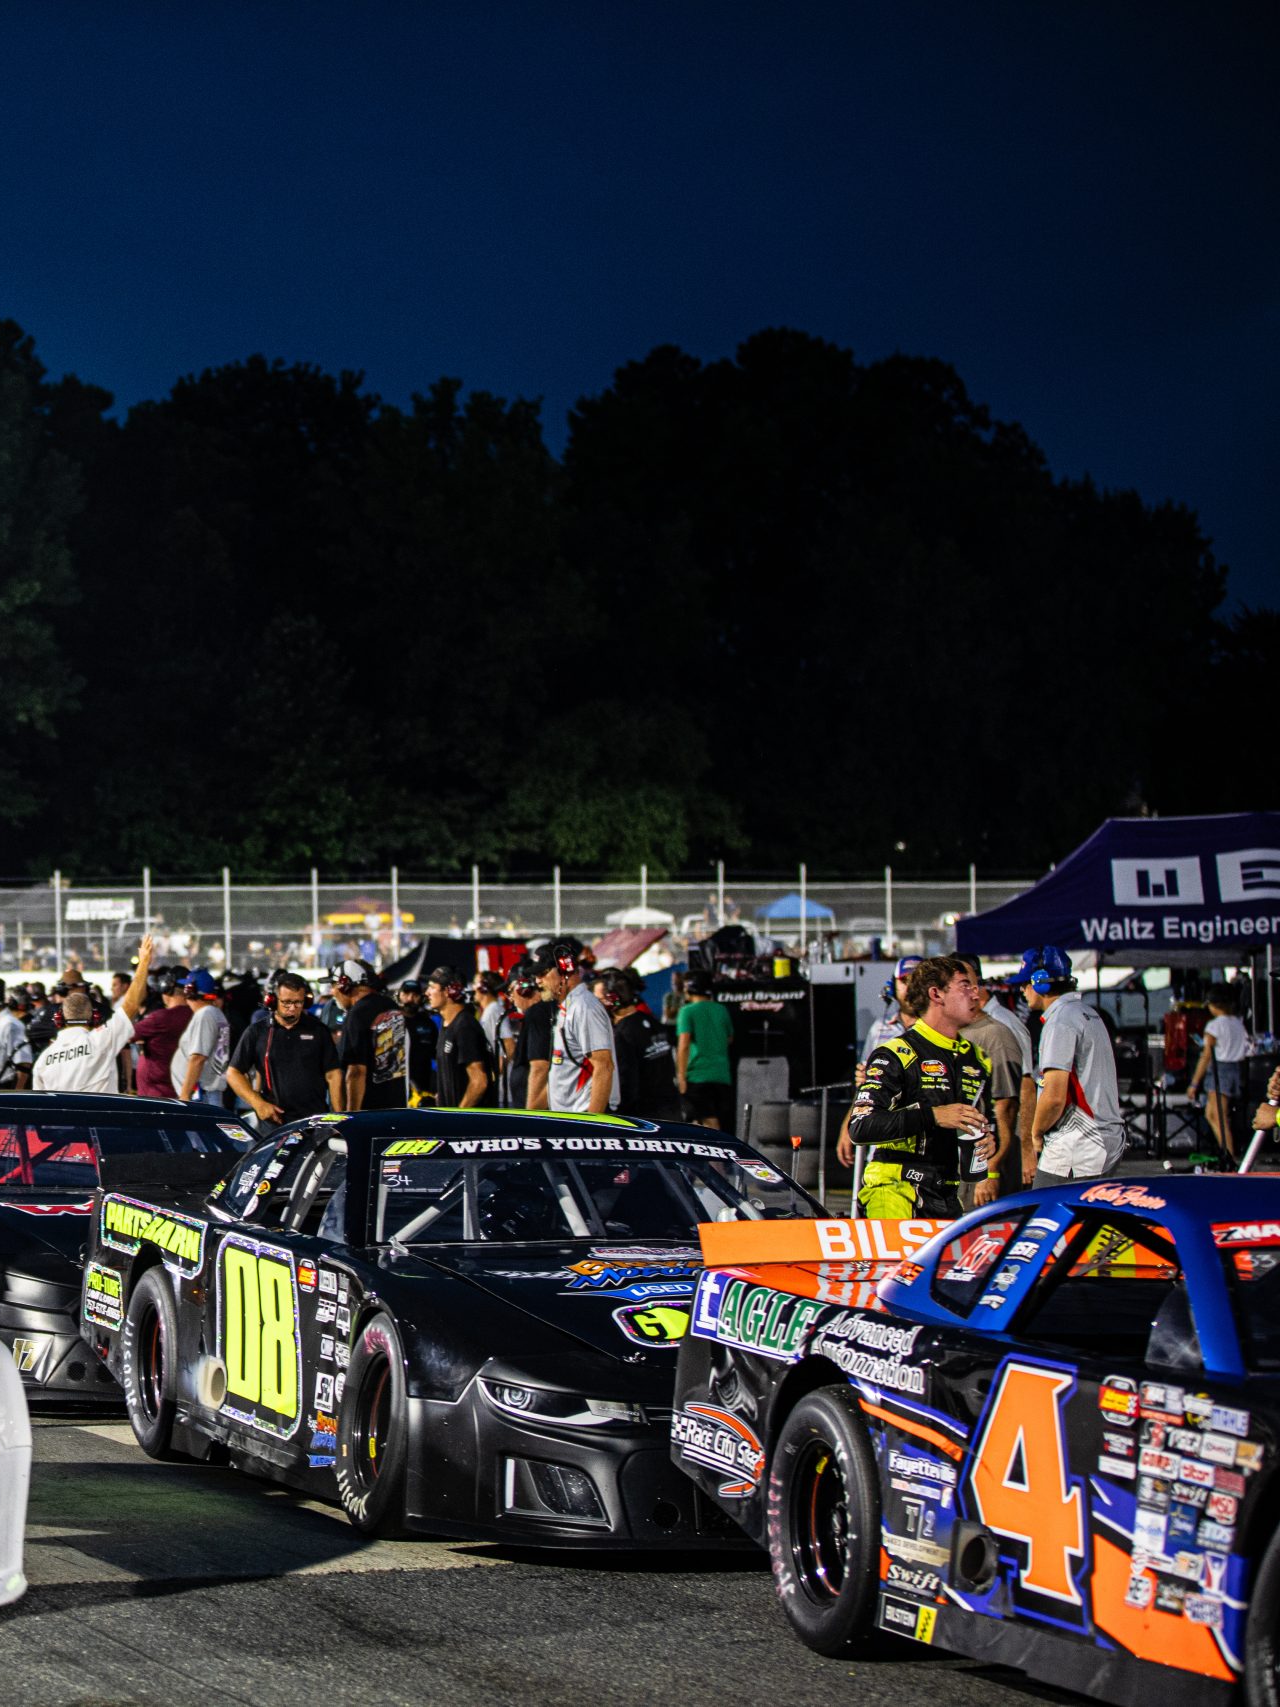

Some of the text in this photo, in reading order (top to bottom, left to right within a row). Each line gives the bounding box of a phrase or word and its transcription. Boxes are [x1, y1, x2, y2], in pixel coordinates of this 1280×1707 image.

[1081, 917, 1155, 942] Waltz
[45, 1044, 91, 1066] OFFICIAL
[384, 1137, 737, 1160] 08 WHO'S YOUR DRIVER?
[384, 1174, 413, 1187] 34
[631, 1283, 693, 1297] USED
[223, 1246, 300, 1418] 08
[818, 1310, 923, 1356] Advanced
[811, 1333, 925, 1395] Automation
[685, 1419, 766, 1472] Race City Steel
[888, 1449, 957, 1487] Fayetteville
[972, 1363, 1084, 1606] 4
[888, 1563, 941, 1590] Swift
[885, 1604, 917, 1628] BILSTEIN
